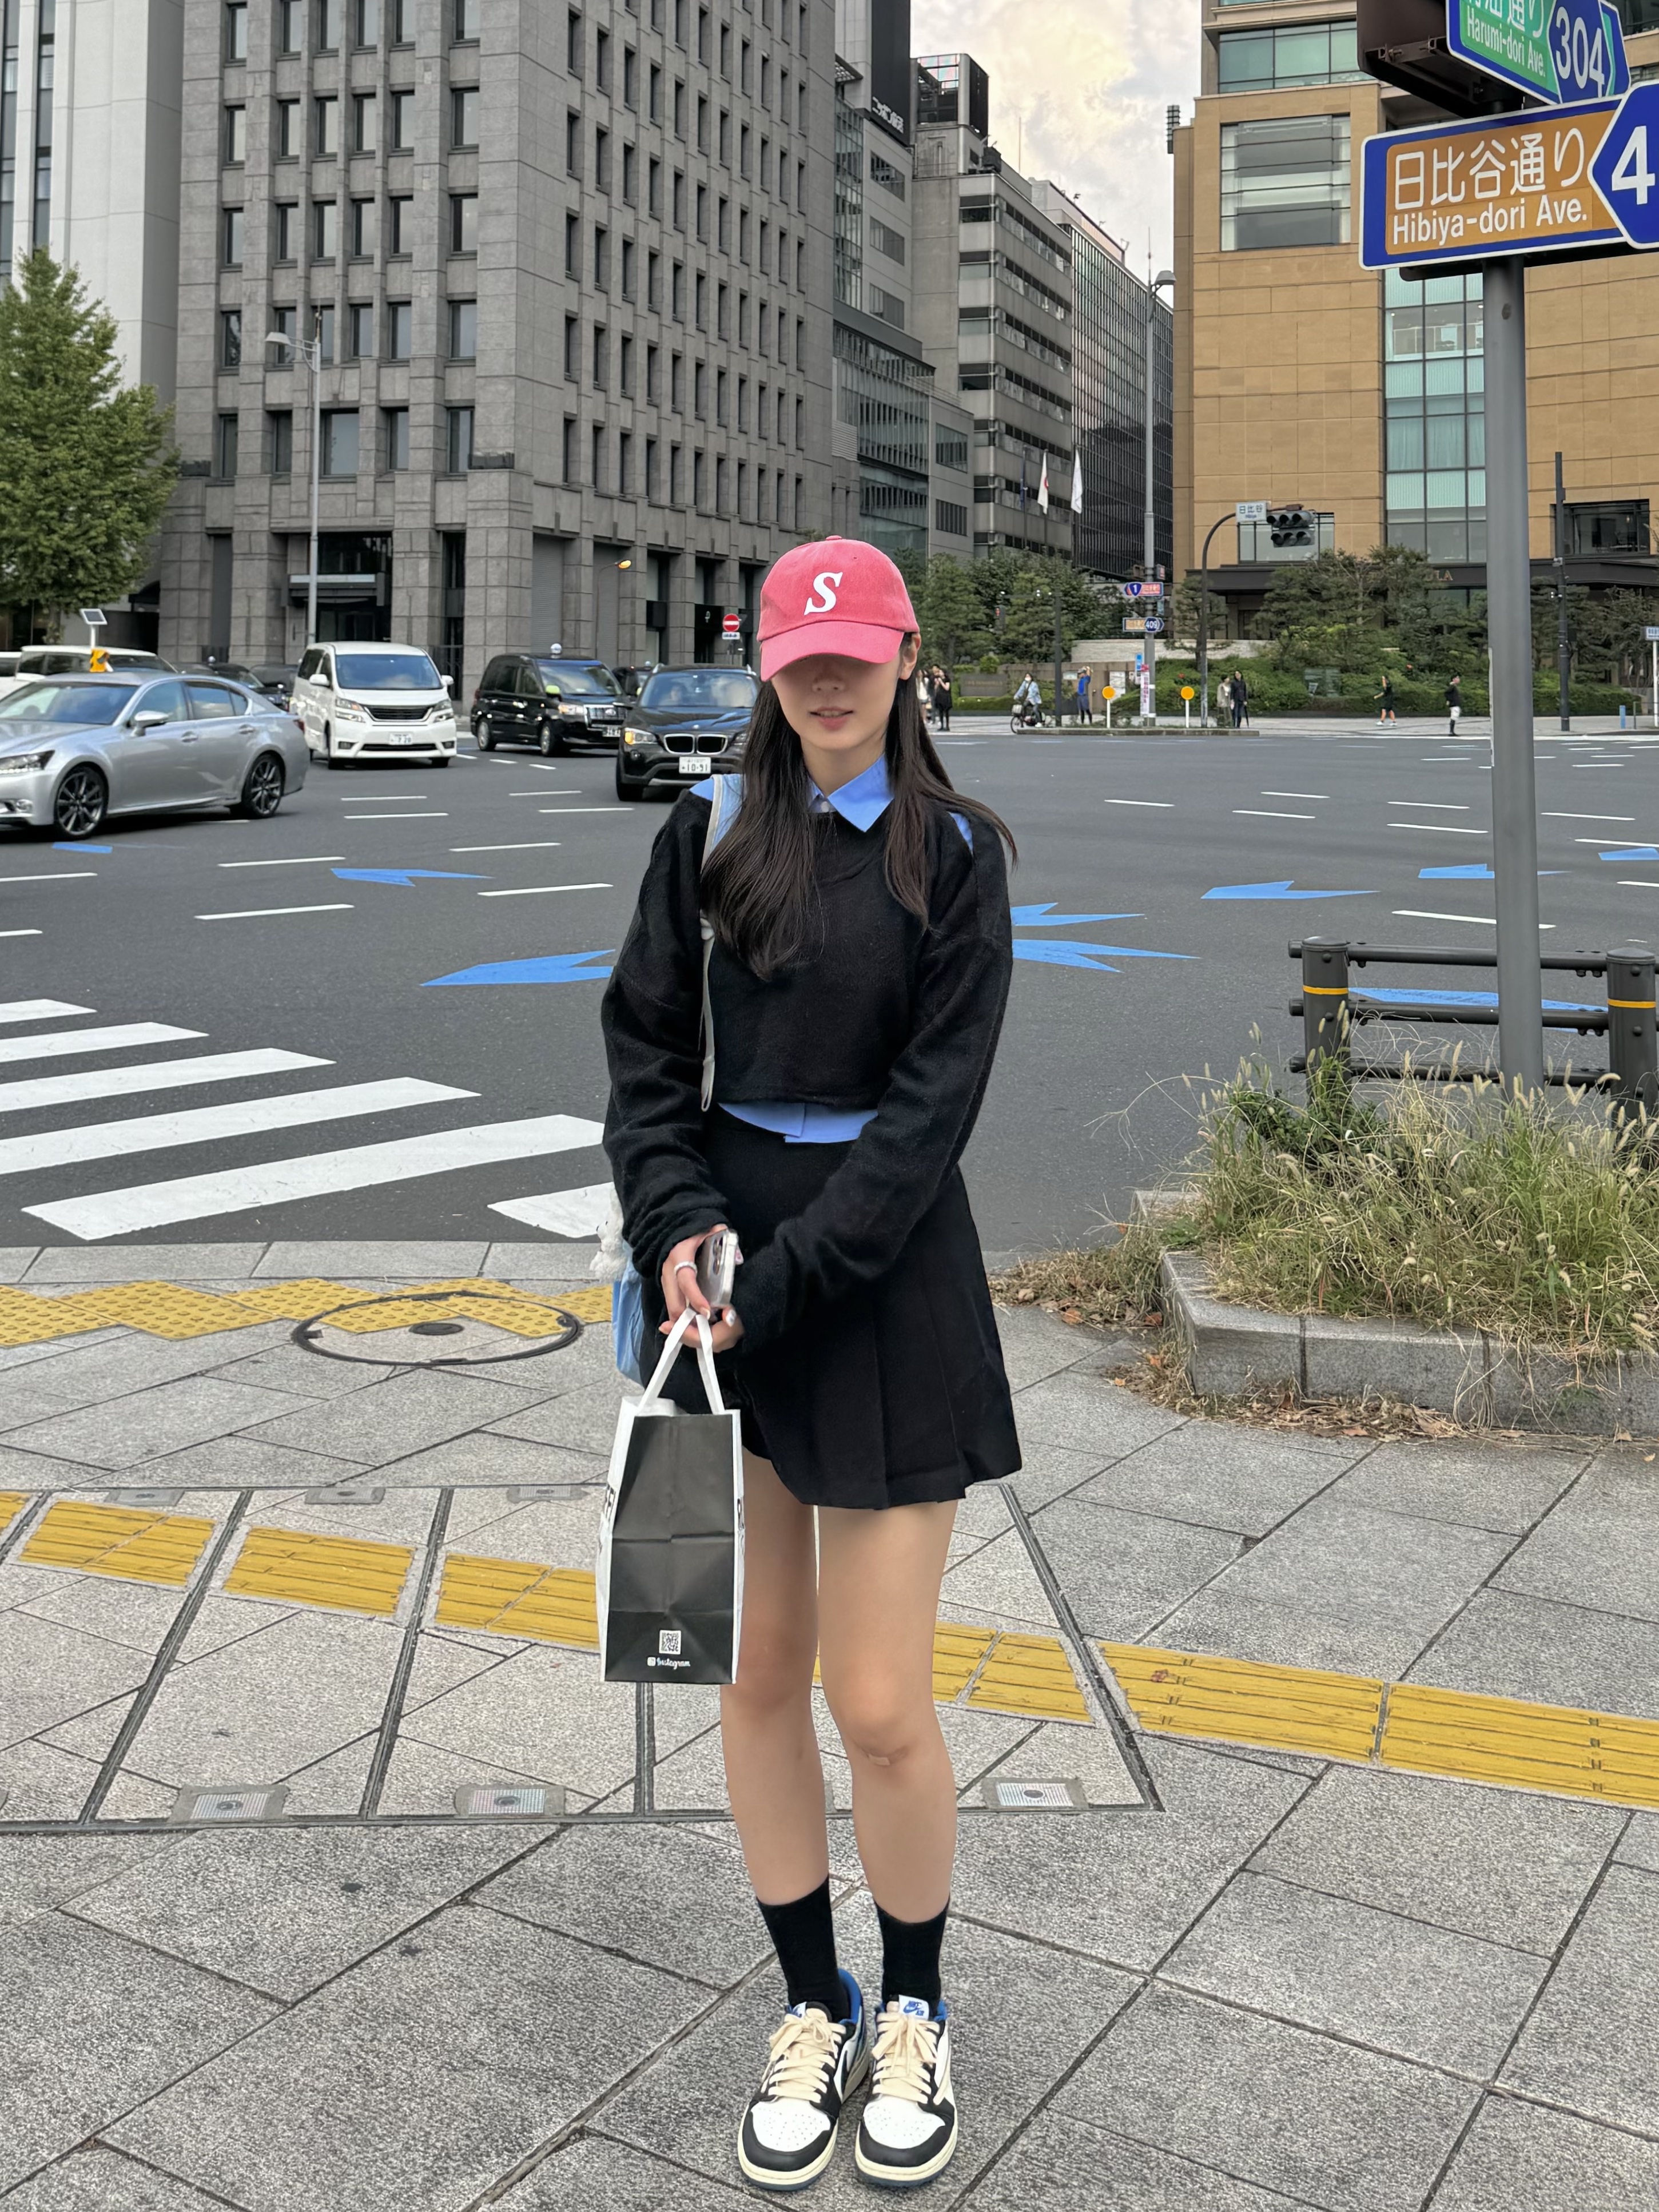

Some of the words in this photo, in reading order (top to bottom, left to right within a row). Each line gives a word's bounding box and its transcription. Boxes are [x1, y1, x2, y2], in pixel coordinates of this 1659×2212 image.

[1466, 5, 1525, 67] Harumi-dori
[1527, 40, 1546, 77] Ave.
[1555, 6, 1605, 98] 304
[1395, 128, 1585, 210] 日比谷通り
[1612, 125, 1656, 205] 4
[1393, 197, 1526, 246] Hibiya-dori
[1535, 194, 1588, 227] Ave.
[803, 572, 844, 616] S
[1132, 584, 1138, 594] 1
[656, 1657, 691, 1670] Instagram
